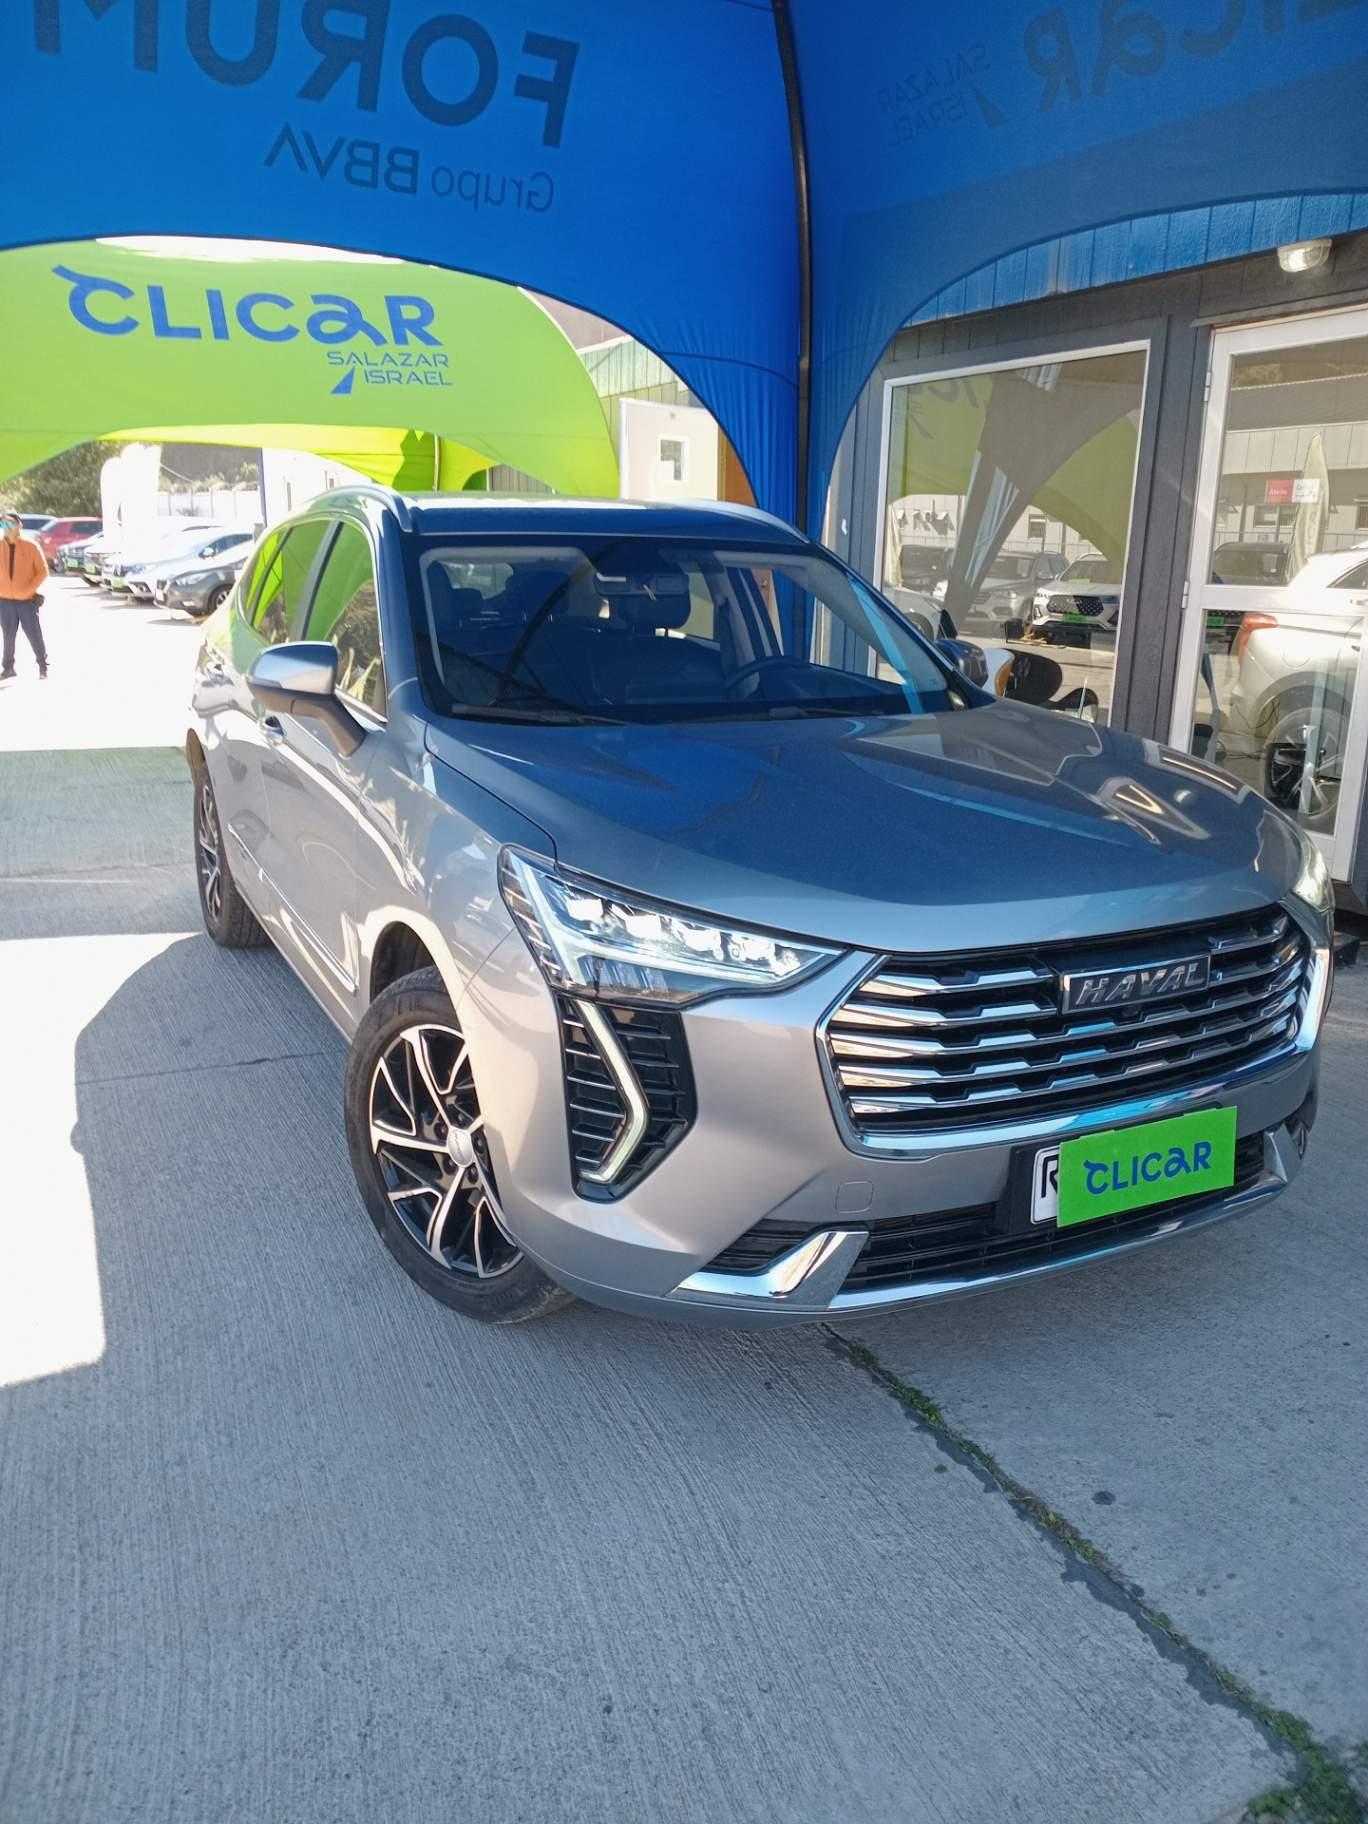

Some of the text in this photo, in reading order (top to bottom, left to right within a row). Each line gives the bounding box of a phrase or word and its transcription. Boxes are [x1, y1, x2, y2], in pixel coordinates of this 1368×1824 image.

[327, 350, 449, 368] SALAZAR
[364, 370, 454, 386] ISRAEL
[1075, 962, 1206, 1006] HAVAL
